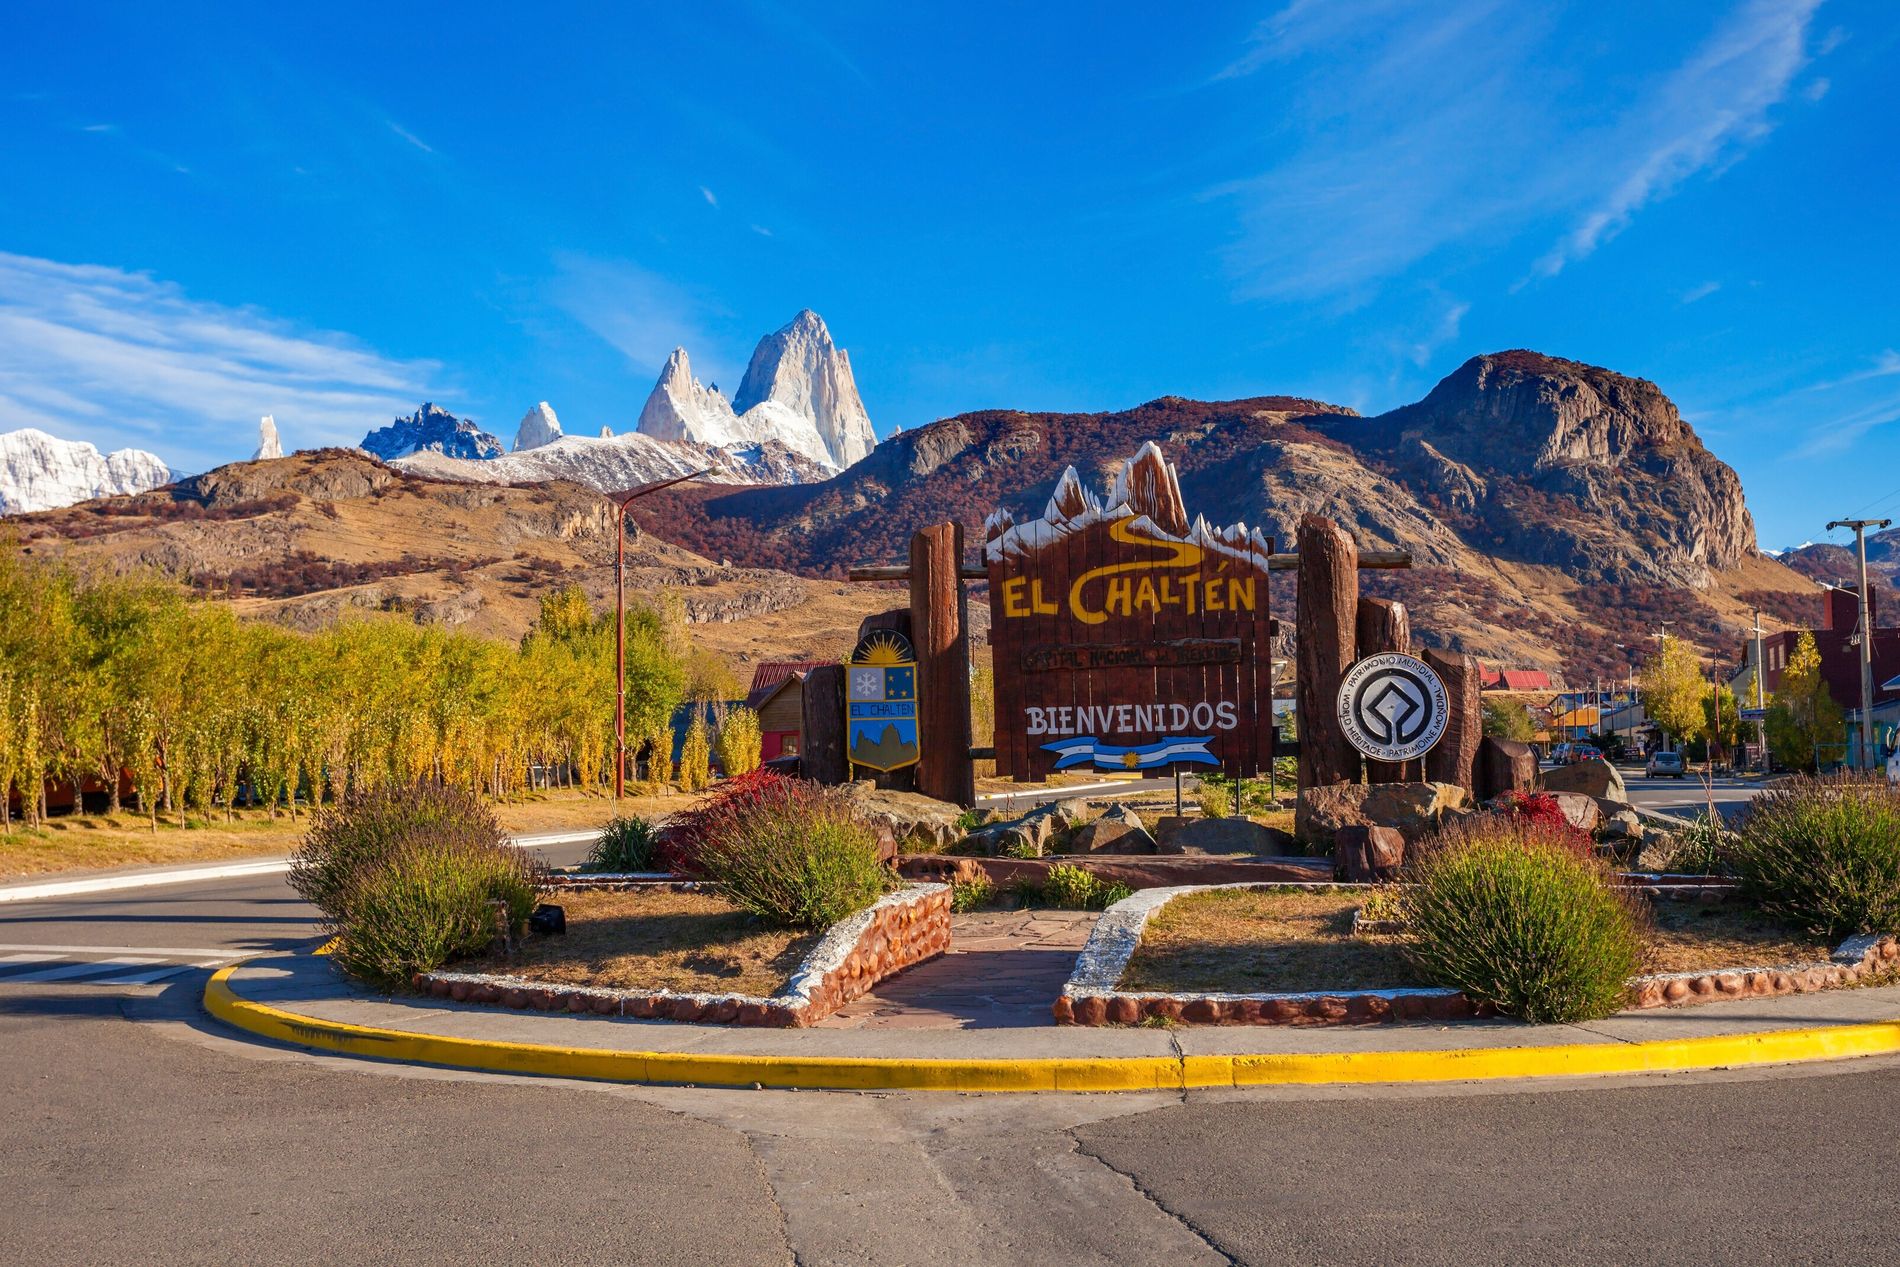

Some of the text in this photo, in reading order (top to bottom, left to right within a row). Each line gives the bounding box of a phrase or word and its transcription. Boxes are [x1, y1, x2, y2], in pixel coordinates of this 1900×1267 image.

[1003, 560, 1256, 625] EL CHALTÉN
[1349, 657, 1435, 687] PATRIMONIO MUNDIAL
[851, 703, 915, 716] EL CHALTEN
[1025, 701, 1238, 735] BIENVENIDOS
[1389, 687, 1446, 757] PATRIMOINE MONDIAL
[1348, 726, 1382, 756] HERITAGE
